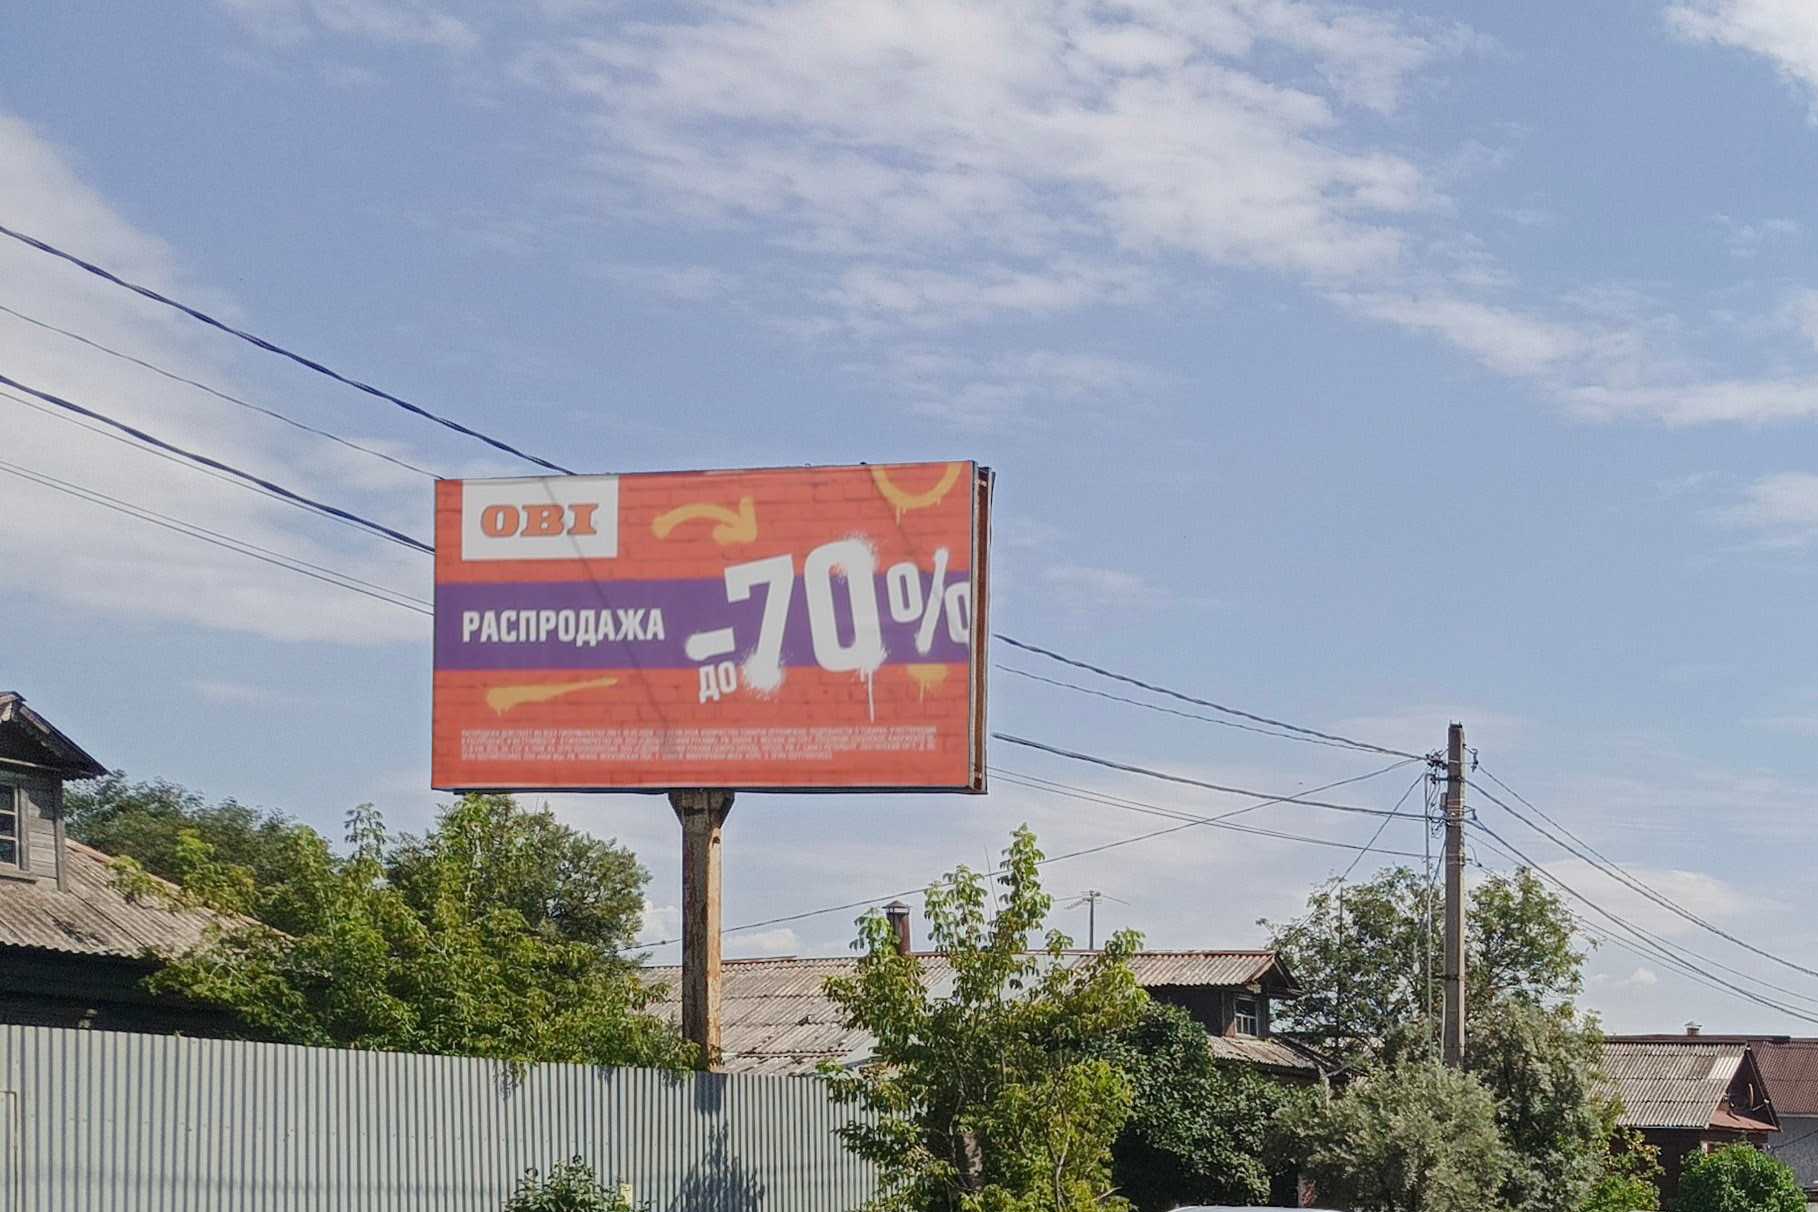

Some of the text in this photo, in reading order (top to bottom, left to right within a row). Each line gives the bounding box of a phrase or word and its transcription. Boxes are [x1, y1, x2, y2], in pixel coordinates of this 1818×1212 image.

[481, 503, 599, 537] OBI
[462, 608, 665, 646] РАСПРОДАЖА
[686, 537, 970, 691] -70%
